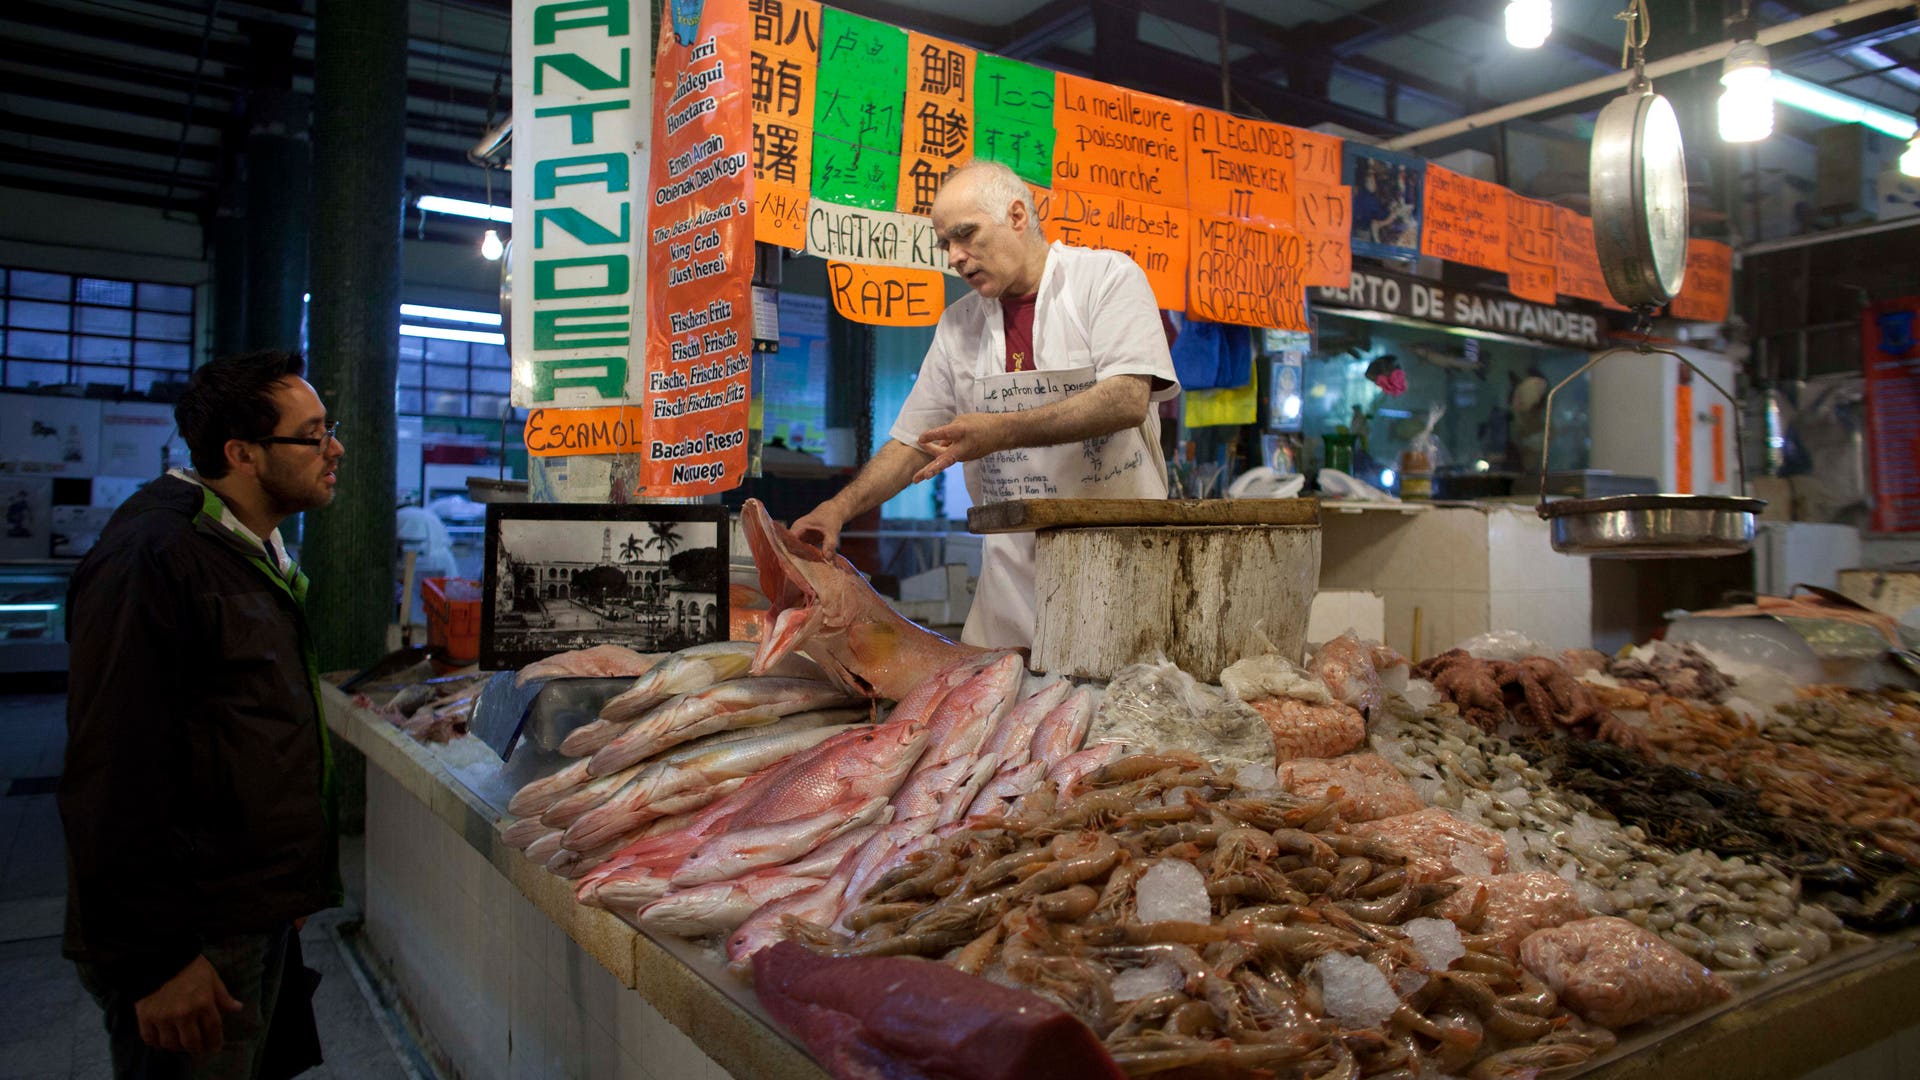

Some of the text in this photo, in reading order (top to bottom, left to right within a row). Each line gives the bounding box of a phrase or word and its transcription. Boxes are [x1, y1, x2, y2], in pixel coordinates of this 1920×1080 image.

[1063, 77, 1174, 132] La meilleure
[1193, 112, 1206, 142] A
[1056, 152, 1162, 195] du marché
[1052, 189, 1101, 227] Die
[1107, 200, 1180, 239] allerbeste
[1229, 188, 1254, 218] ITT
[670, 230, 720, 261] king Crab
[1146, 246, 1169, 272] im
[830, 263, 930, 317] RAPE
[670, 309, 707, 333] Fischers
[709, 300, 731, 322] Fritz
[1411, 283, 1445, 318] DE
[1453, 293, 1599, 345] SANTANDER
[703, 329, 737, 354] Frische
[690, 361, 724, 385] Frische
[725, 353, 750, 377] Fische
[687, 390, 724, 413] Fischers
[983, 381, 998, 400] Le
[1002, 378, 1033, 401] patron
[1034, 379, 1046, 394] de
[1047, 377, 1059, 393] la
[651, 437, 703, 459] Bacalao
